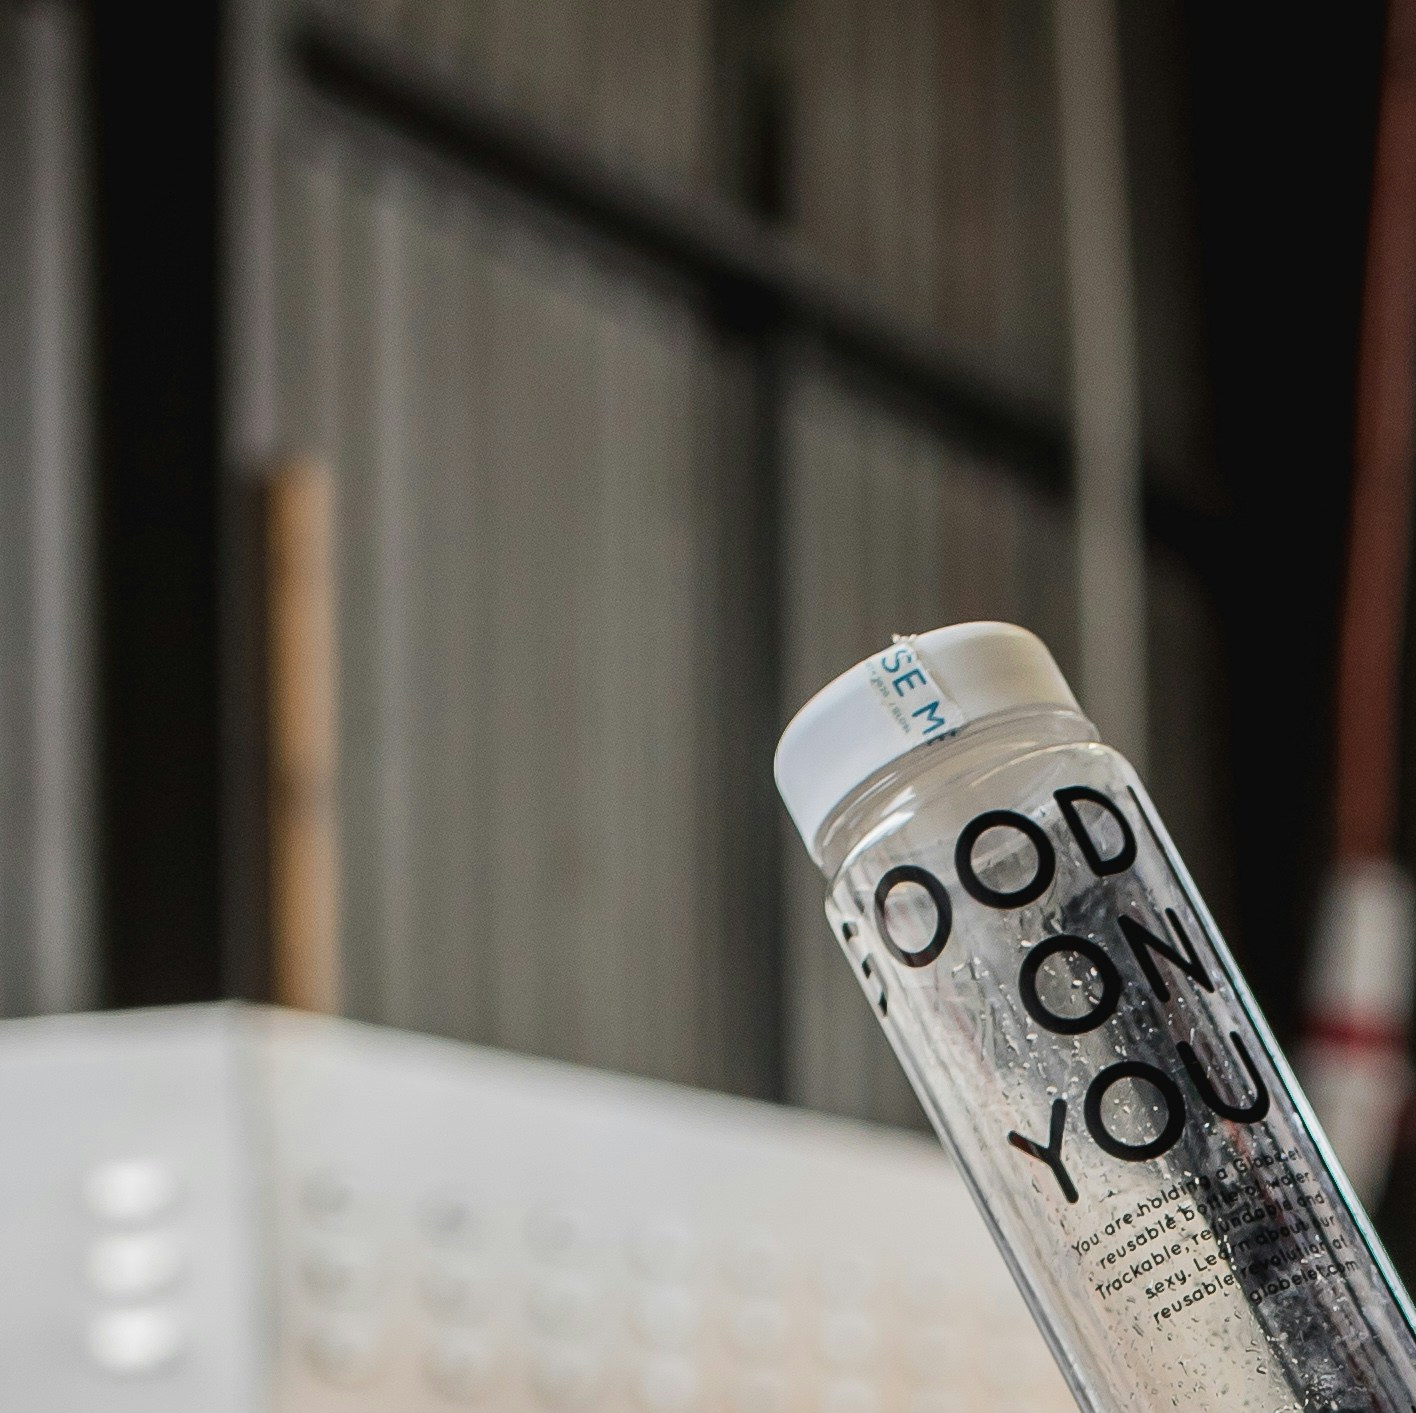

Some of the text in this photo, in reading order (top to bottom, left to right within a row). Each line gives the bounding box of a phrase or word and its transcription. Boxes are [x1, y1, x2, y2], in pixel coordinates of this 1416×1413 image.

[1018, 907, 1215, 1036] ON
[1007, 1030, 1271, 1204] YOU
[1071, 1233, 1100, 1257] You
[1104, 1213, 1133, 1236] are
[1137, 1175, 1211, 1218] holding
[1216, 1168, 1229, 1180] a
[1095, 1191, 1325, 1301] Trackable, refundable and
[1100, 1219, 1176, 1270] reusable
[1182, 1191, 1239, 1222] bottle
[1145, 1270, 1192, 1299] sexy.
[1193, 1241, 1250, 1273] Learn
[1256, 1218, 1310, 1245] about
[1153, 1234, 1348, 1324] reusable revolution at
[1250, 1261, 1358, 1303] globelet.com
